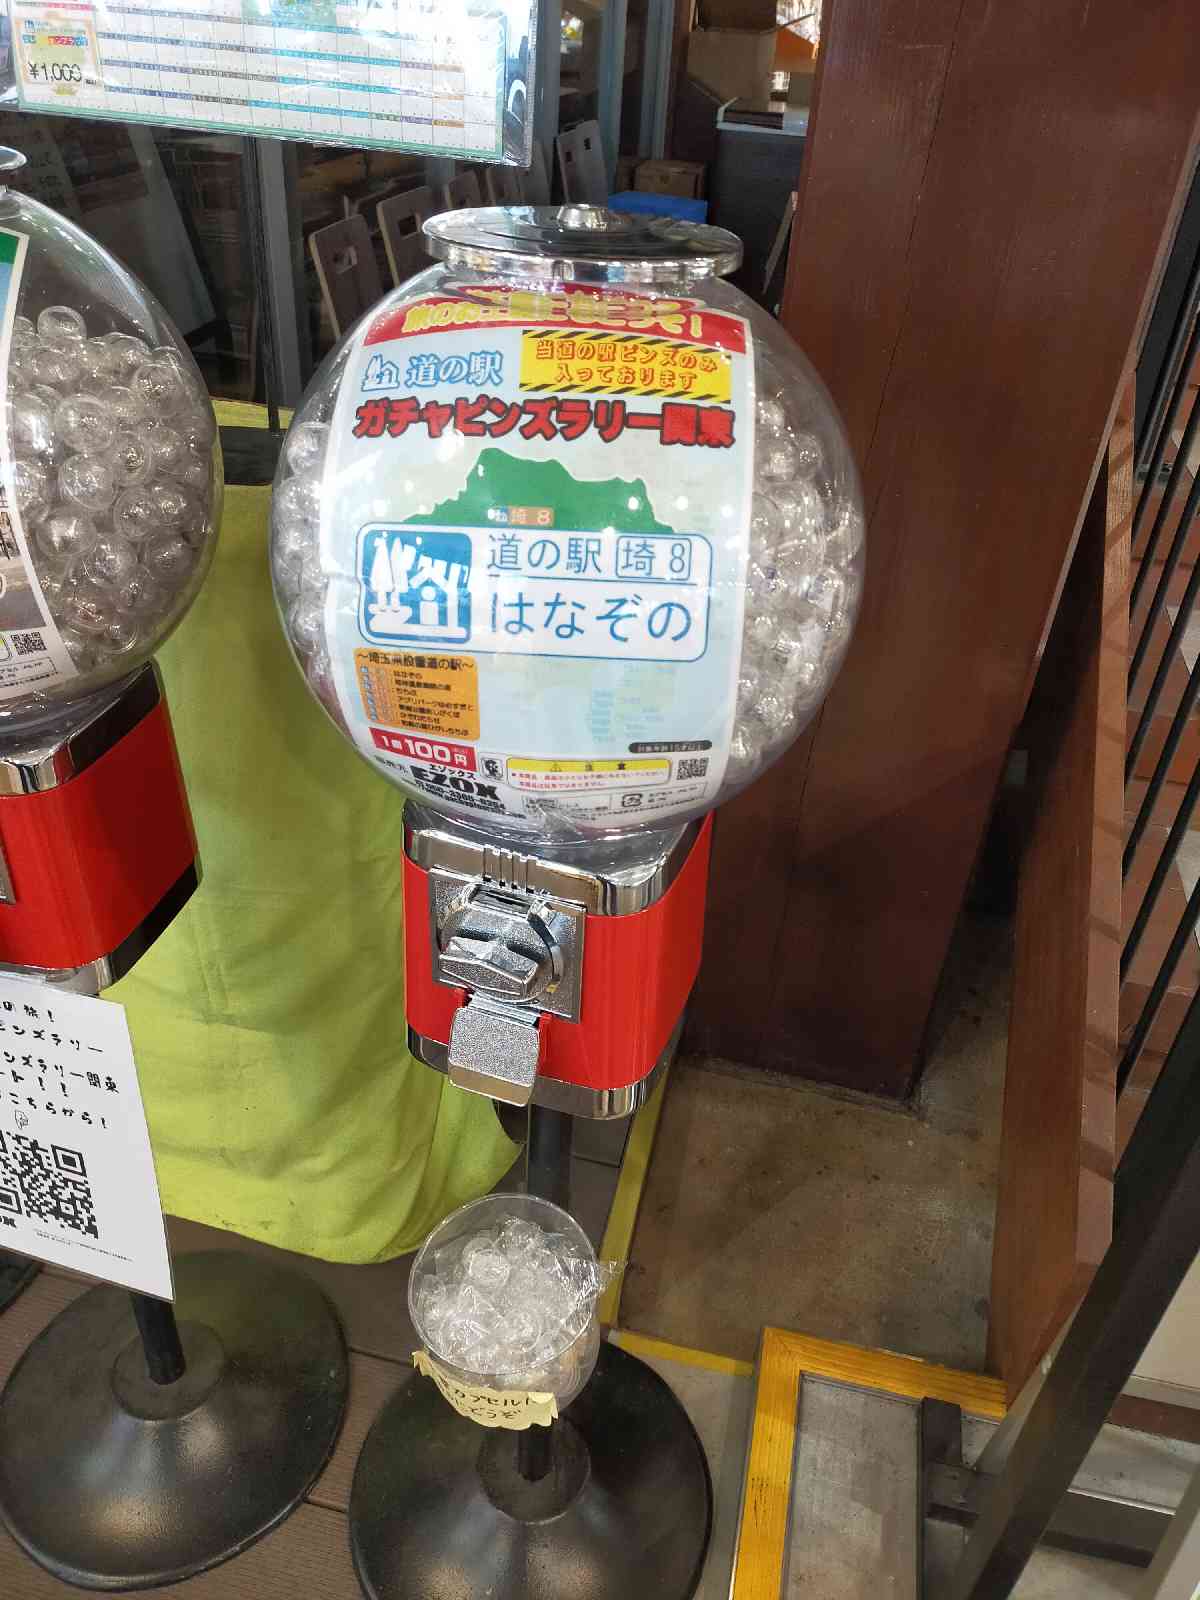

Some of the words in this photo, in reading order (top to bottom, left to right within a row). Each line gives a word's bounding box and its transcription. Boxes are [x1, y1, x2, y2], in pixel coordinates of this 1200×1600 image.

[405, 350, 504, 388] 道の駅
[536, 339, 718, 373] 当道の駅ピンズのみ
[556, 363, 698, 391] 入っております
[352, 394, 735, 448] ガチャピンズラリー関東
[488, 533, 602, 575] 道の駅
[490, 591, 693, 643] はなぞの
